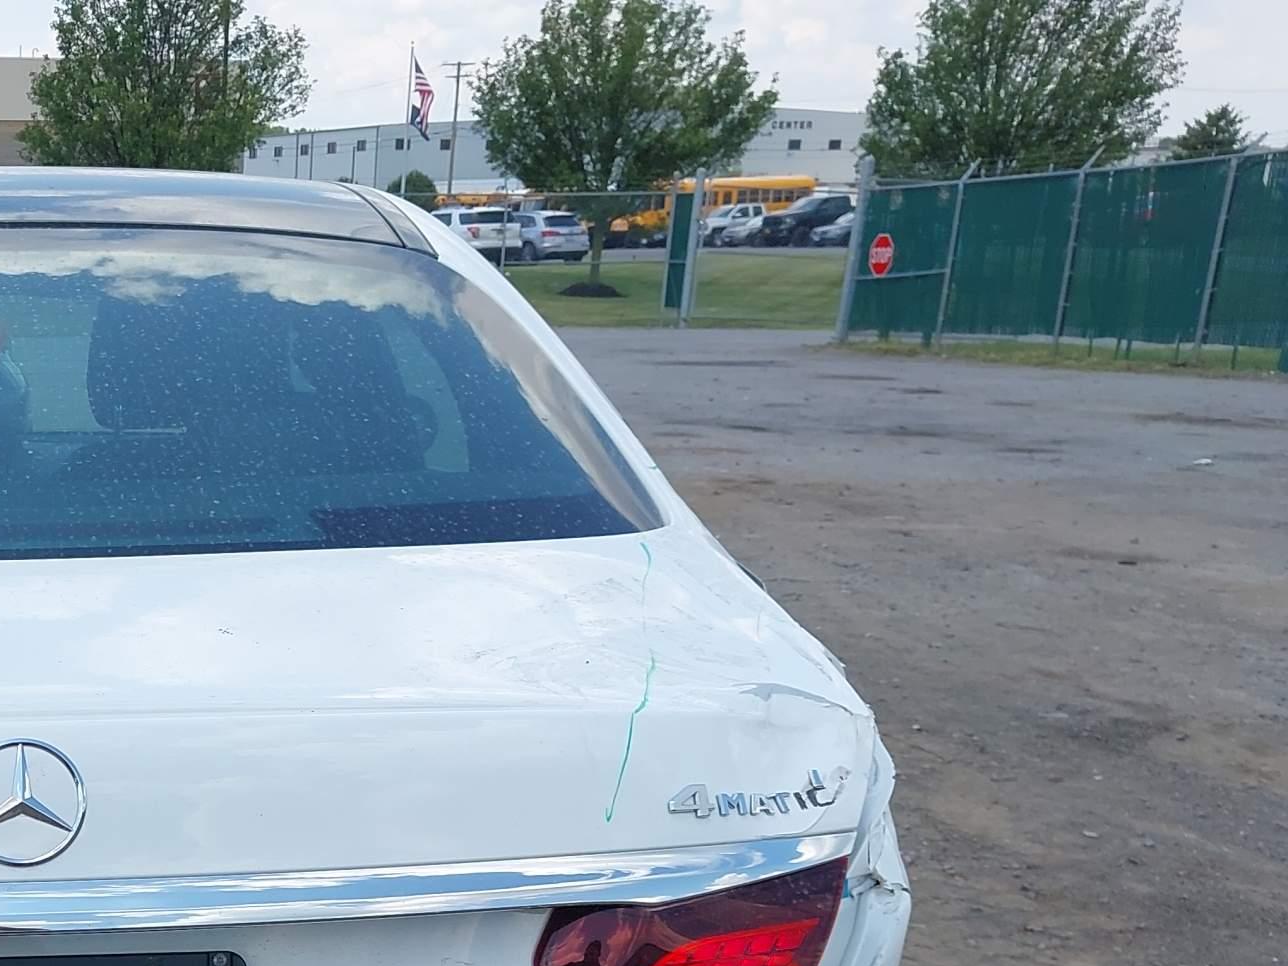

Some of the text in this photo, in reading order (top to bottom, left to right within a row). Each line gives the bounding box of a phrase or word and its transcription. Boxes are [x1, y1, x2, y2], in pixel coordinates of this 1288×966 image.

[772, 121, 813, 129] CENTER
[871, 247, 893, 264] STOP
[668, 768, 848, 818] 4MATIC
